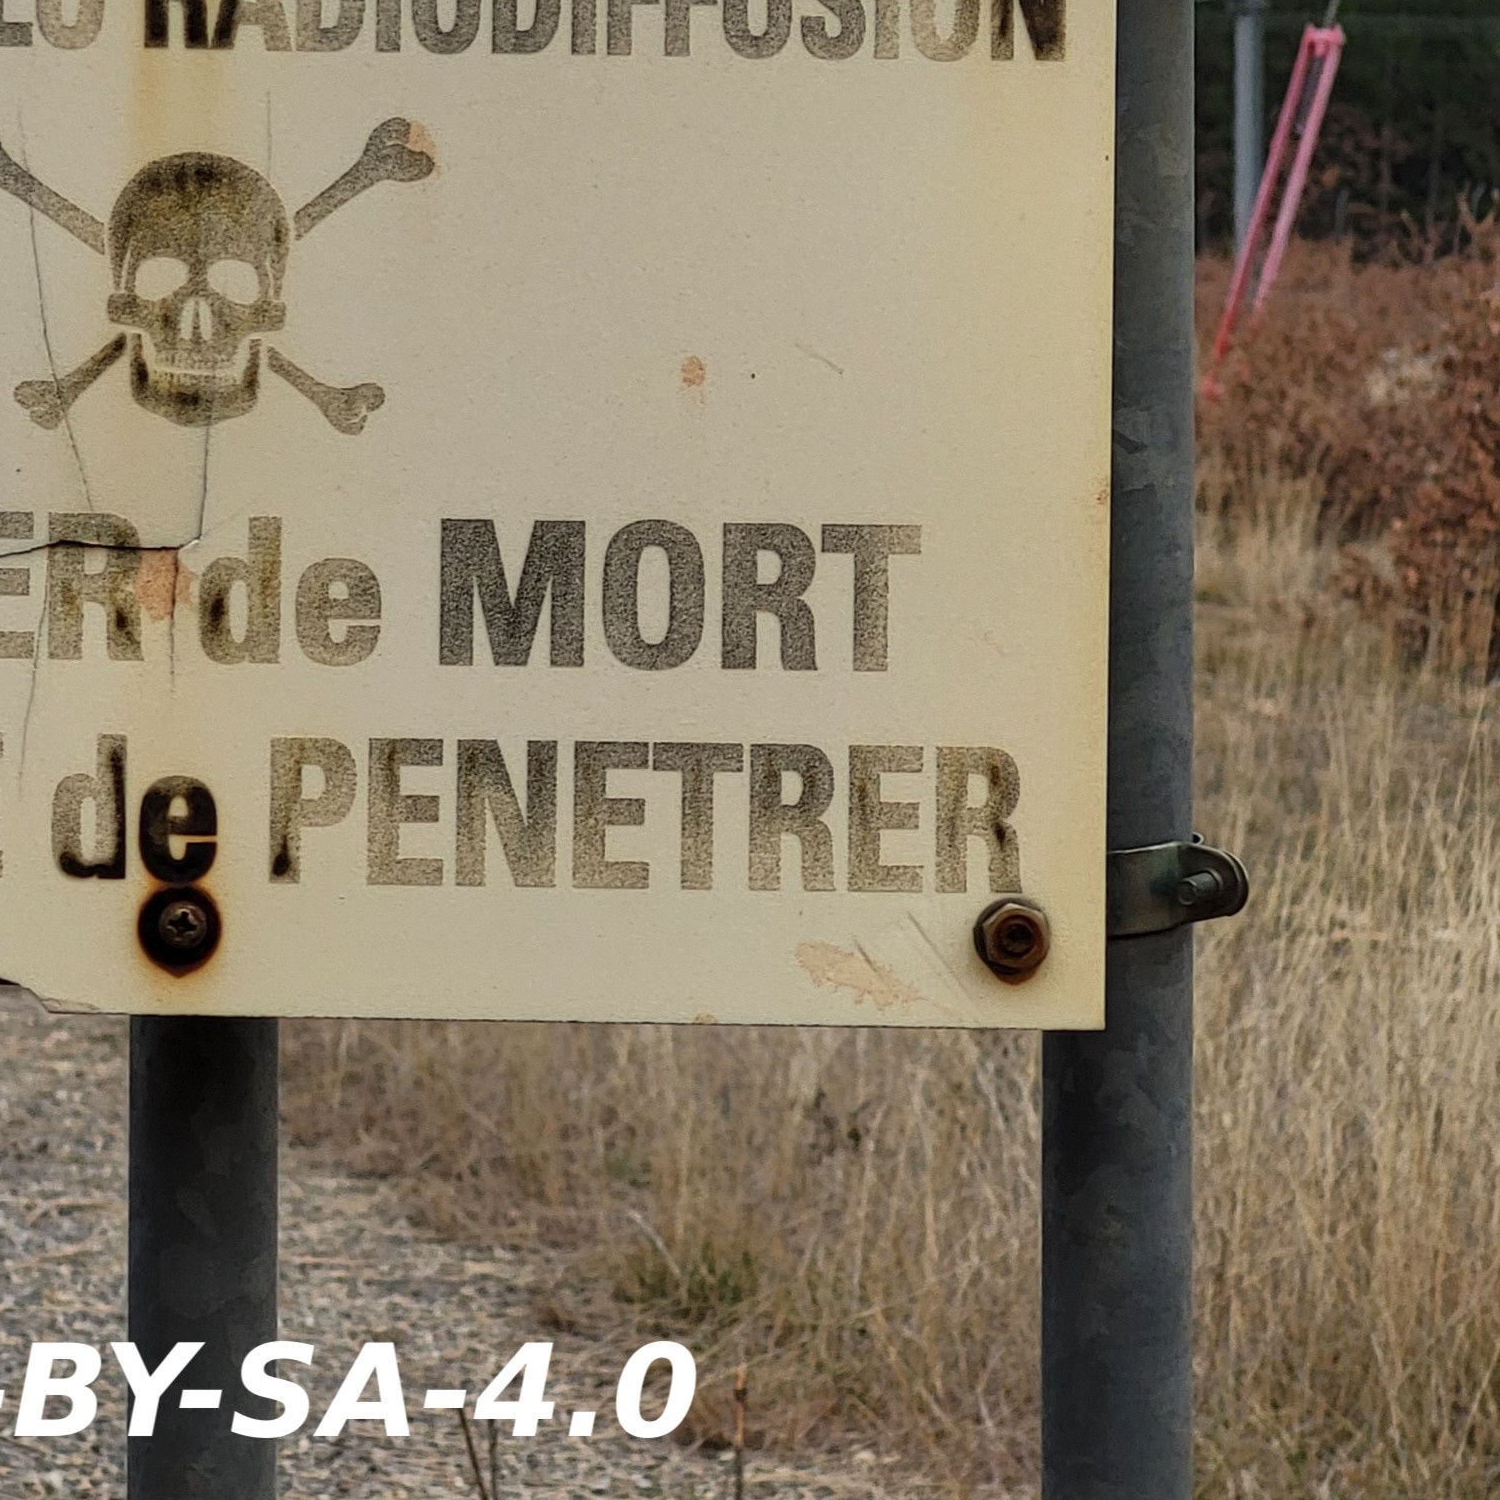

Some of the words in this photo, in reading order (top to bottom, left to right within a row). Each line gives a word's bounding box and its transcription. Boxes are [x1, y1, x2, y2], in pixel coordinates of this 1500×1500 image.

[198, 516, 383, 666] de
[439, 518, 923, 672] MORT
[51, 733, 218, 882] de
[269, 737, 1022, 894] PENETRER
